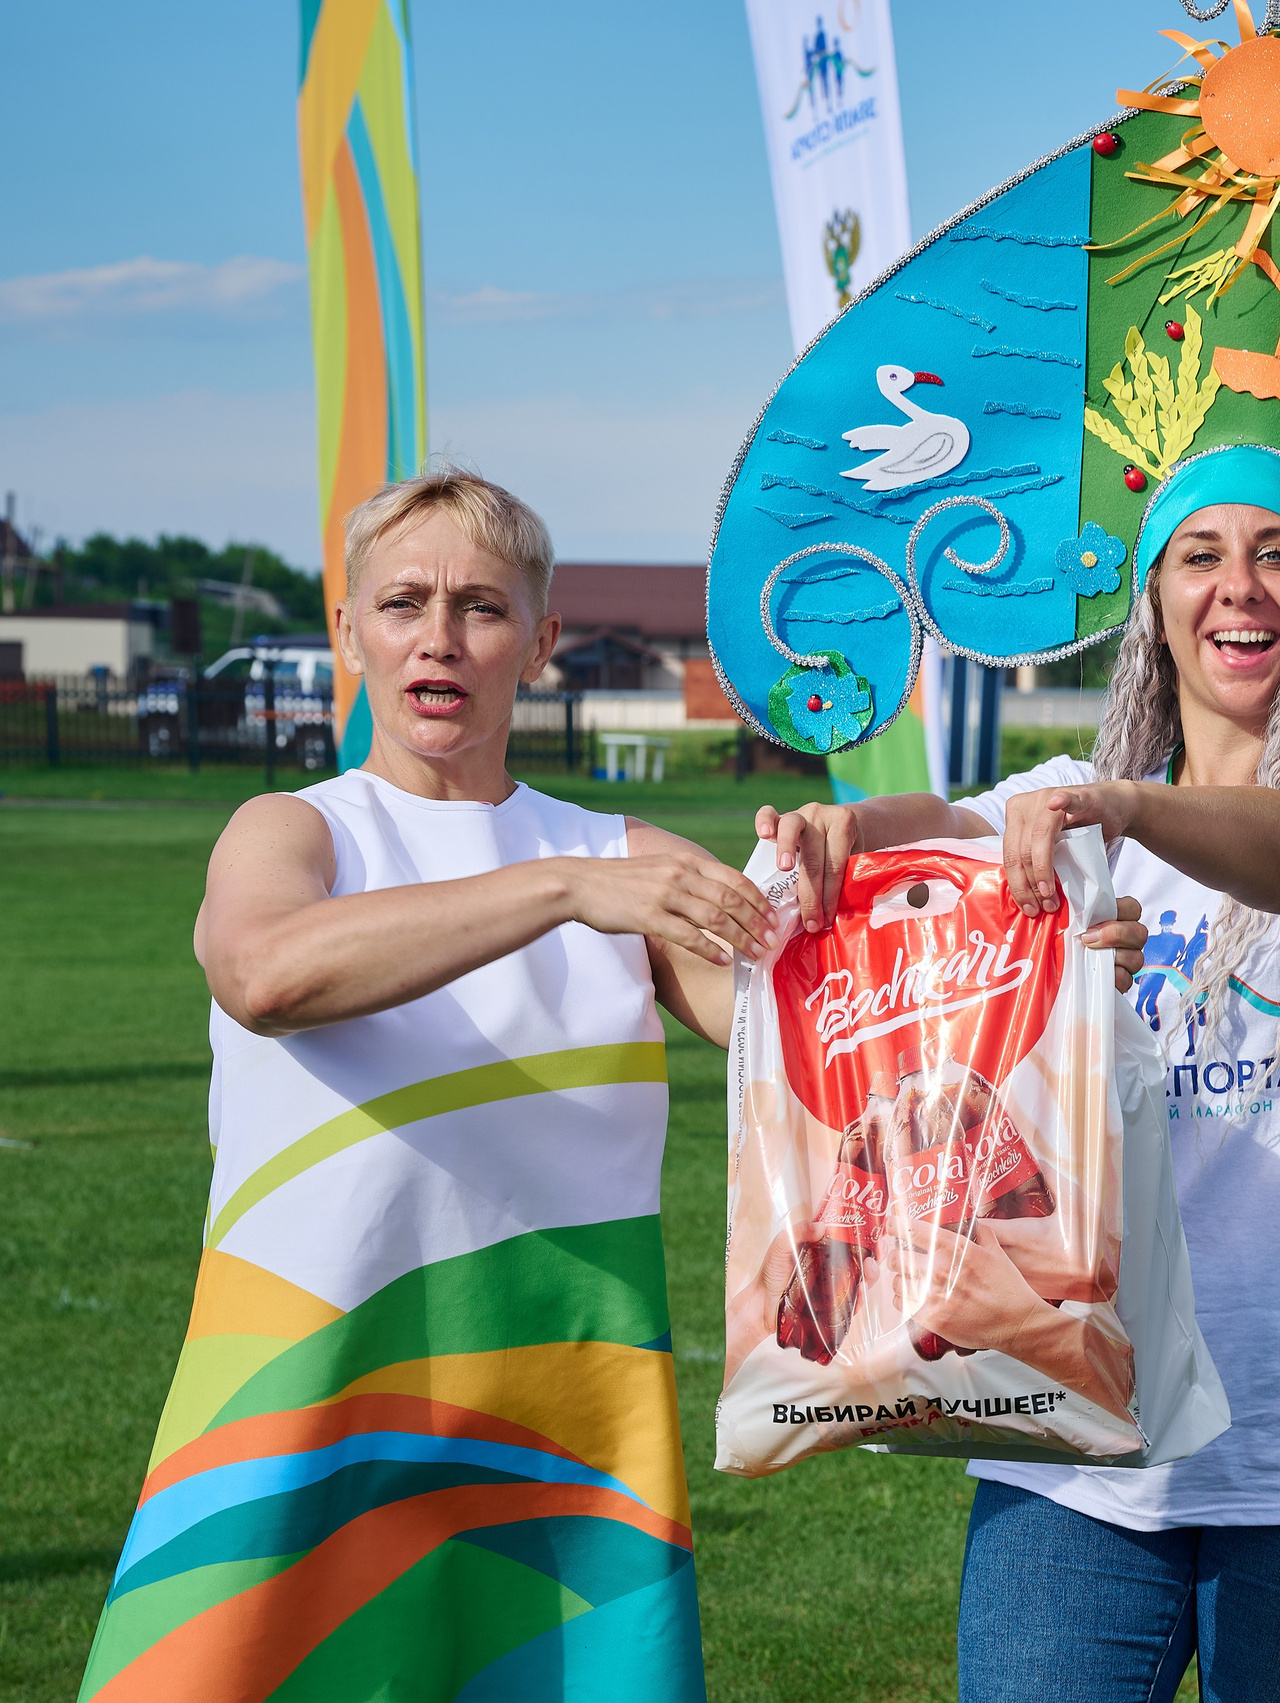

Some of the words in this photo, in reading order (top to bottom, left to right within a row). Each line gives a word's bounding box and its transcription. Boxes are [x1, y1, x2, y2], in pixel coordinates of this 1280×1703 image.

[805, 929, 1034, 1054] Bochkari
[827, 1172, 886, 1212] Cola
[892, 1152, 964, 1195] Cola
[772, 1397, 917, 1424] ВЫБИРАЙ
